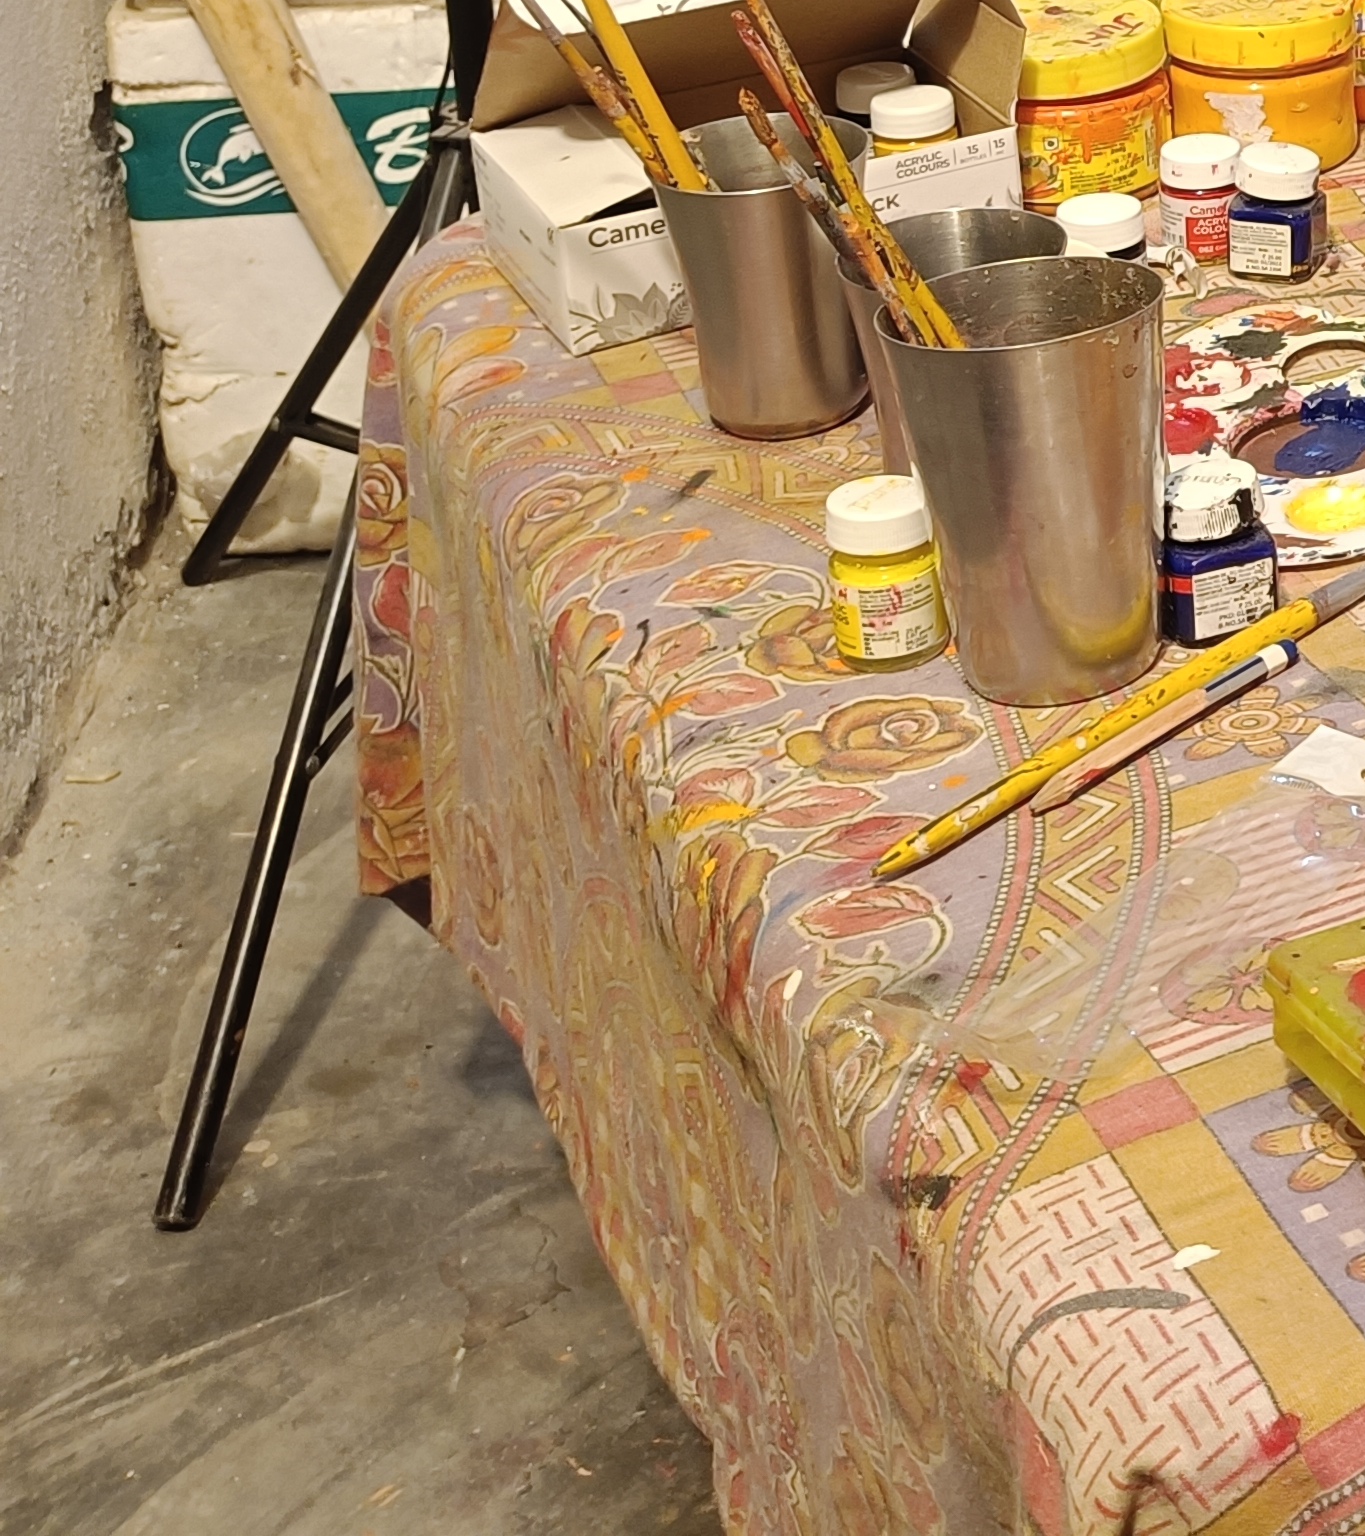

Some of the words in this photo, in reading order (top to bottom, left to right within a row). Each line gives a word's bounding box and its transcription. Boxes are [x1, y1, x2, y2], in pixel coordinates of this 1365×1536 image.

[967, 145, 979, 154] 15
[993, 138, 1005, 149] 15
[896, 151, 943, 170] ACRYLIC
[896, 159, 950, 178] COLOURS
[872, 194, 900, 211] CK
[588, 219, 666, 248] Came
